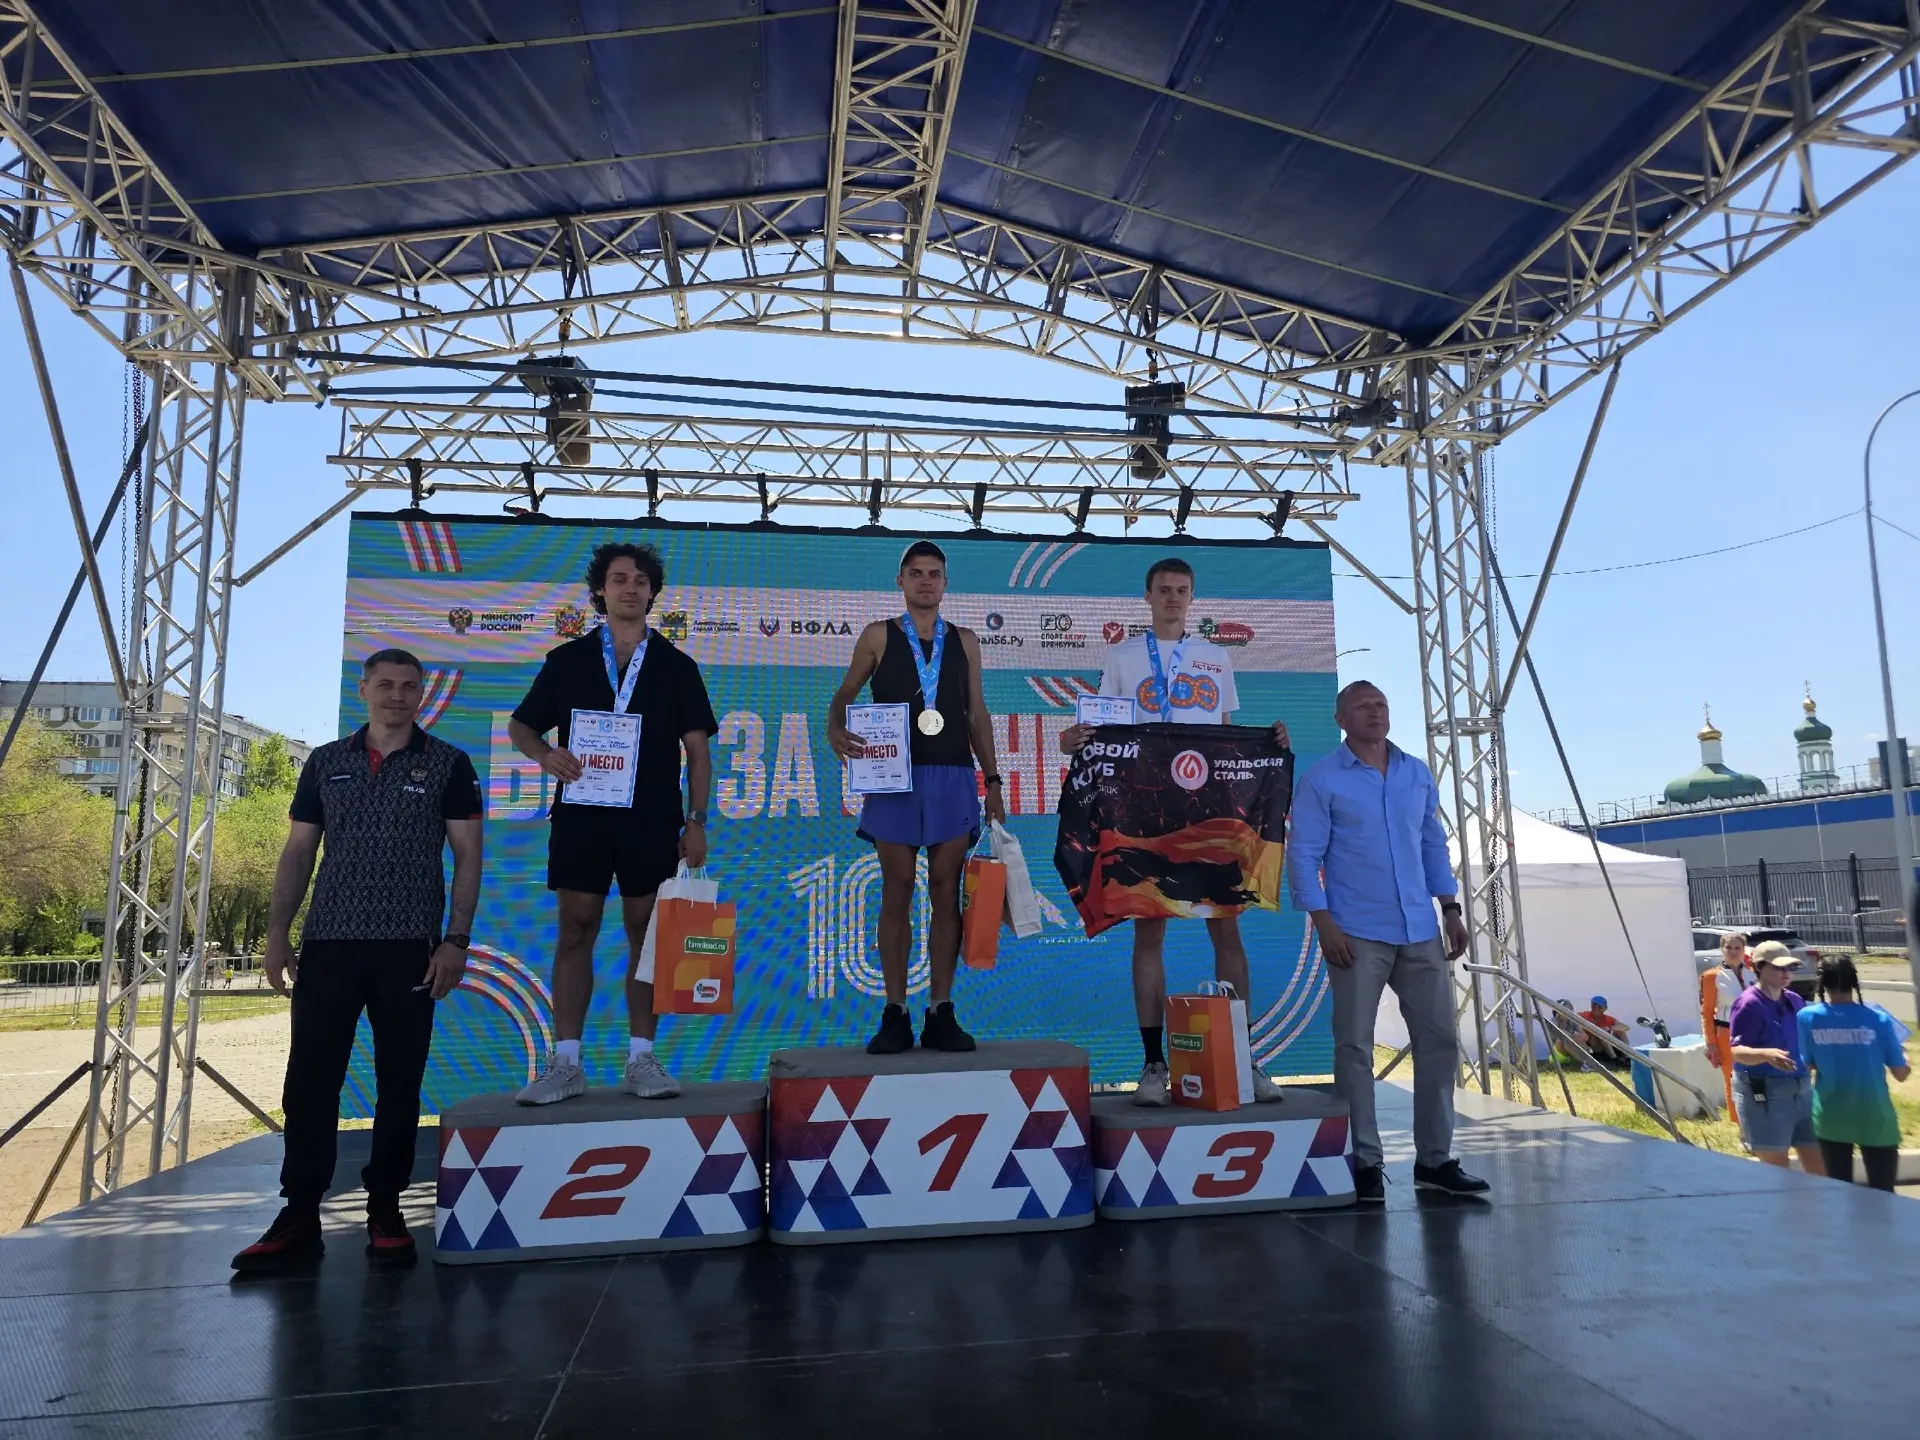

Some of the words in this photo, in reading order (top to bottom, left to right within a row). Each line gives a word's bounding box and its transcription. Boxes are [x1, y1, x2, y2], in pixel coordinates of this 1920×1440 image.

[481, 613, 535, 622] МИНСПОРТ
[480, 623, 522, 631] РОССИИ
[790, 620, 853, 635] ВФЛА
[976, 635, 1024, 647] ал56.Ру
[1041, 633, 1063, 641] СПОРТ
[866, 745, 897, 759] МЕСТО
[1081, 740, 1140, 761] ОВОЙ
[589, 754, 624, 770] МЕСТО
[717, 710, 820, 819] ЗА
[1213, 758, 1284, 768] УРАЛЬСКАЯ
[1213, 771, 1254, 780] СТАЛЬ
[403, 785, 426, 794] RUS
[787, 853, 933, 998] 10
[688, 940, 726, 950] farmlend.ru
[917, 1113, 988, 1192] 1
[1192, 1130, 1275, 1198] 3
[539, 1145, 651, 1220] 2
